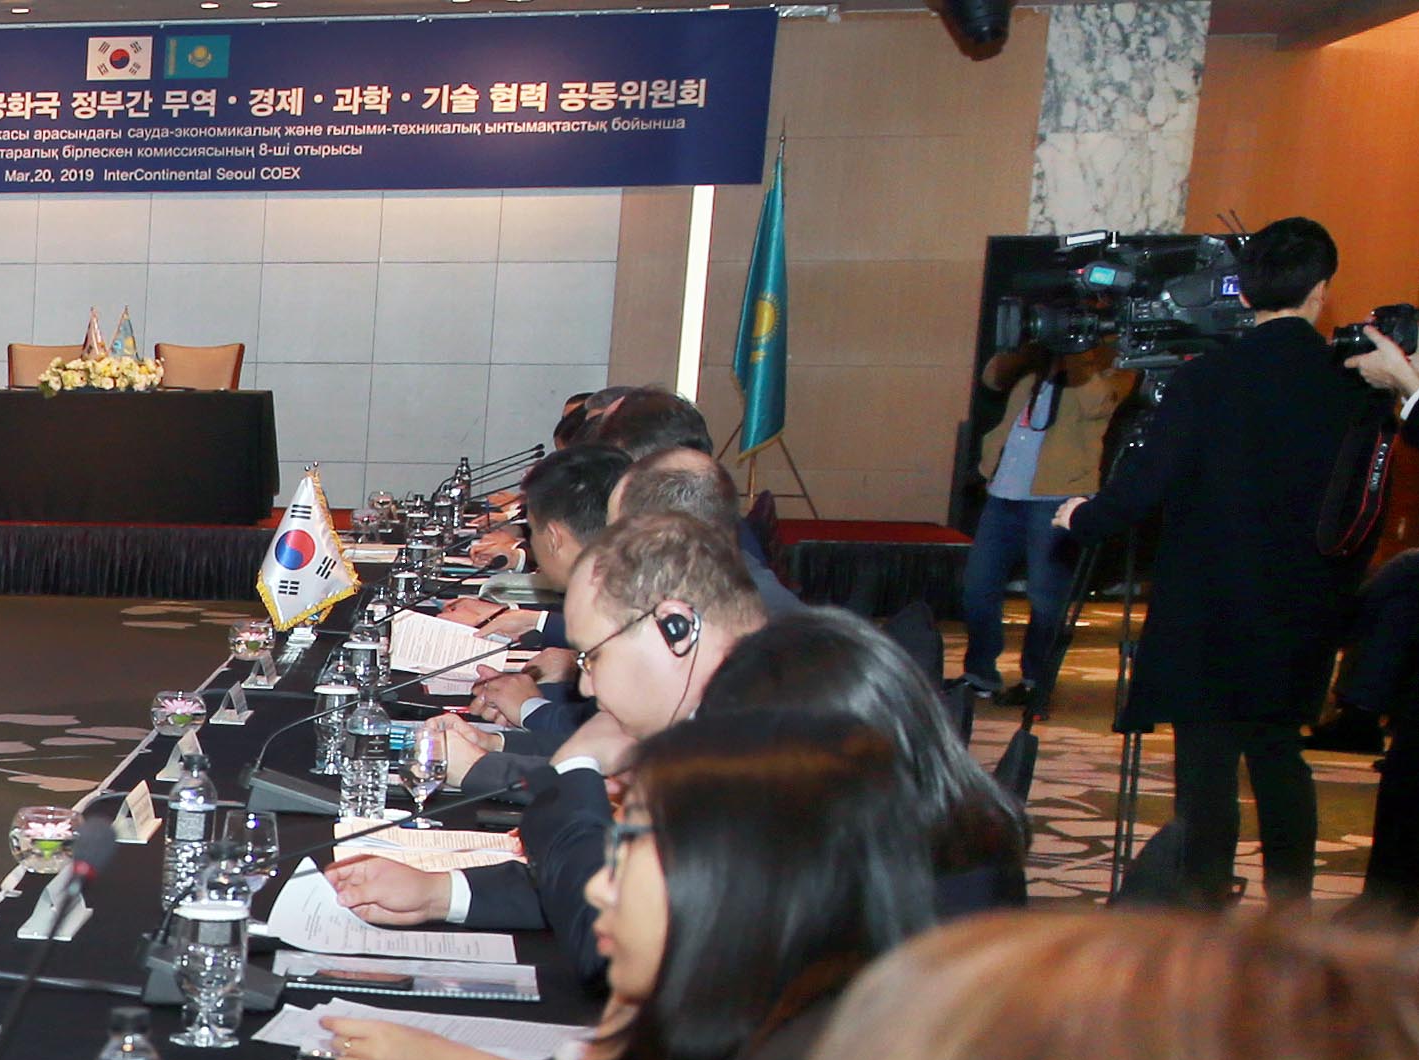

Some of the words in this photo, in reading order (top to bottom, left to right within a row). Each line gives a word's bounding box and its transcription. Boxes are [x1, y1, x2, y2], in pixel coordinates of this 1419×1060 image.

[71, 90, 153, 119] 정부간
[162, 88, 217, 118] 무역
[248, 87, 305, 117] 경제
[332, 84, 392, 115] 과학
[421, 82, 480, 115] 기술
[489, 81, 549, 113] 협력
[557, 78, 707, 111] 공동위원회
[33, 128, 122, 143] арасындағы
[127, 126, 281, 141] сауда-экономикалық
[284, 124, 323, 136] және
[326, 121, 481, 137] ғылыми-техникалық
[484, 120, 607, 135] ынтымақтастық
[611, 116, 686, 131] бойынша
[62, 145, 133, 161] бірлескен
[137, 145, 255, 159] комиссиясының
[259, 142, 290, 157] 8-ші
[294, 143, 363, 158] отырысы
[60, 168, 95, 182] 2019
[104, 166, 212, 182] InterContinental
[216, 166, 256, 181] Seoul
[260, 166, 301, 180] COEX
